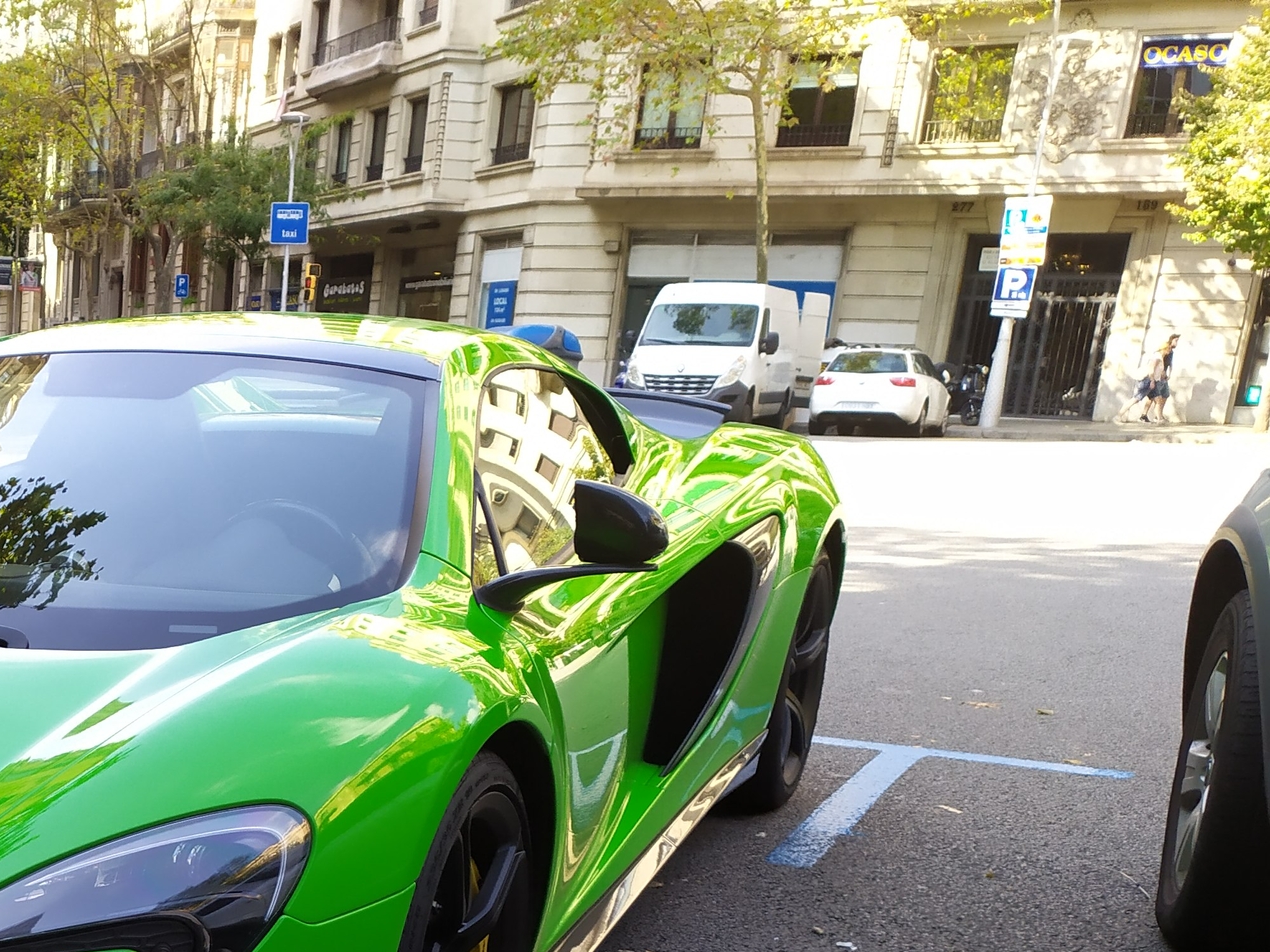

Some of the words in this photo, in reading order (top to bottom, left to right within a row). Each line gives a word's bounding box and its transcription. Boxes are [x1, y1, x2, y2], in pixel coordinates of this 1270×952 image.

[1143, 43, 1228, 64] OCASO
[952, 201, 975, 212] 277
[282, 229, 297, 238] taxi
[178, 278, 186, 287] P
[1000, 269, 1028, 298] P
